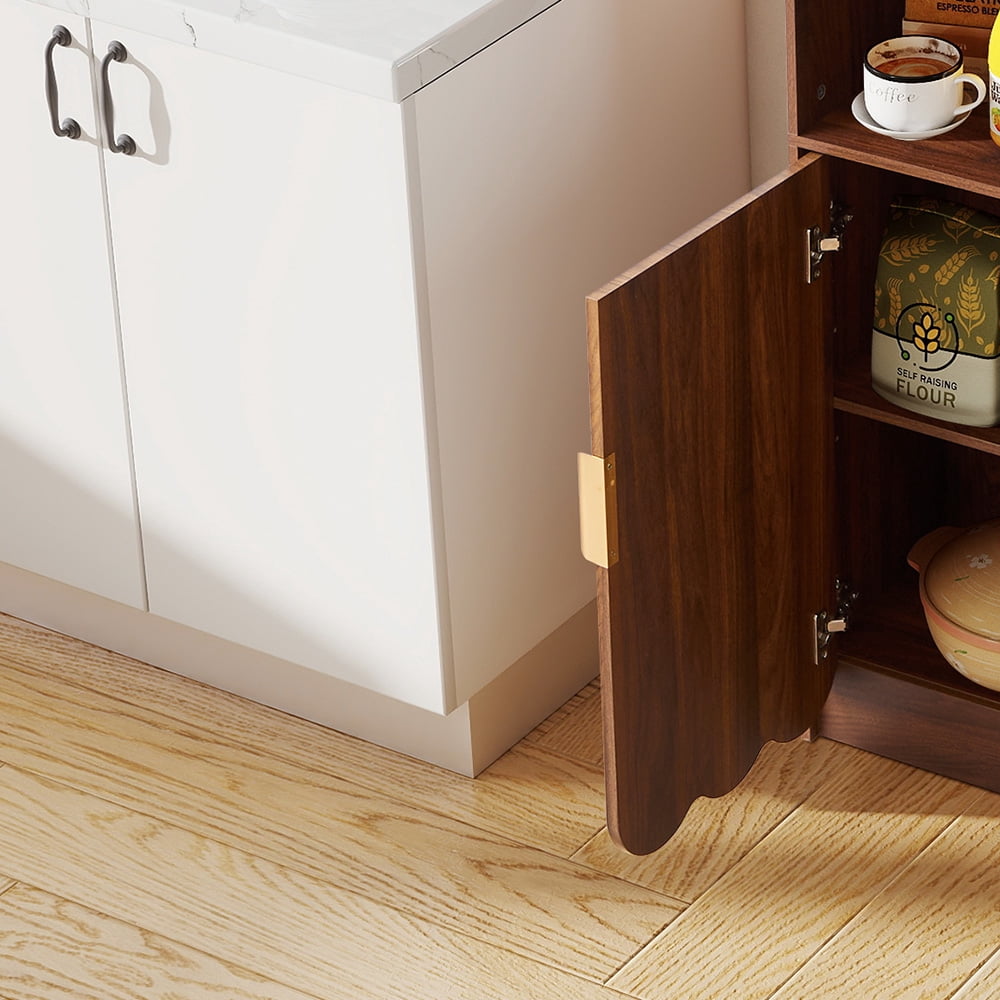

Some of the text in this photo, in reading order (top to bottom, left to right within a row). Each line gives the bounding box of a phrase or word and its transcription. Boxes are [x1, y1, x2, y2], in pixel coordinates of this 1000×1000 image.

[936, 2, 980, 14] ESPRESSO
[896, 367, 958, 390] SELF RAISING
[896, 378, 956, 408] FLOUR
